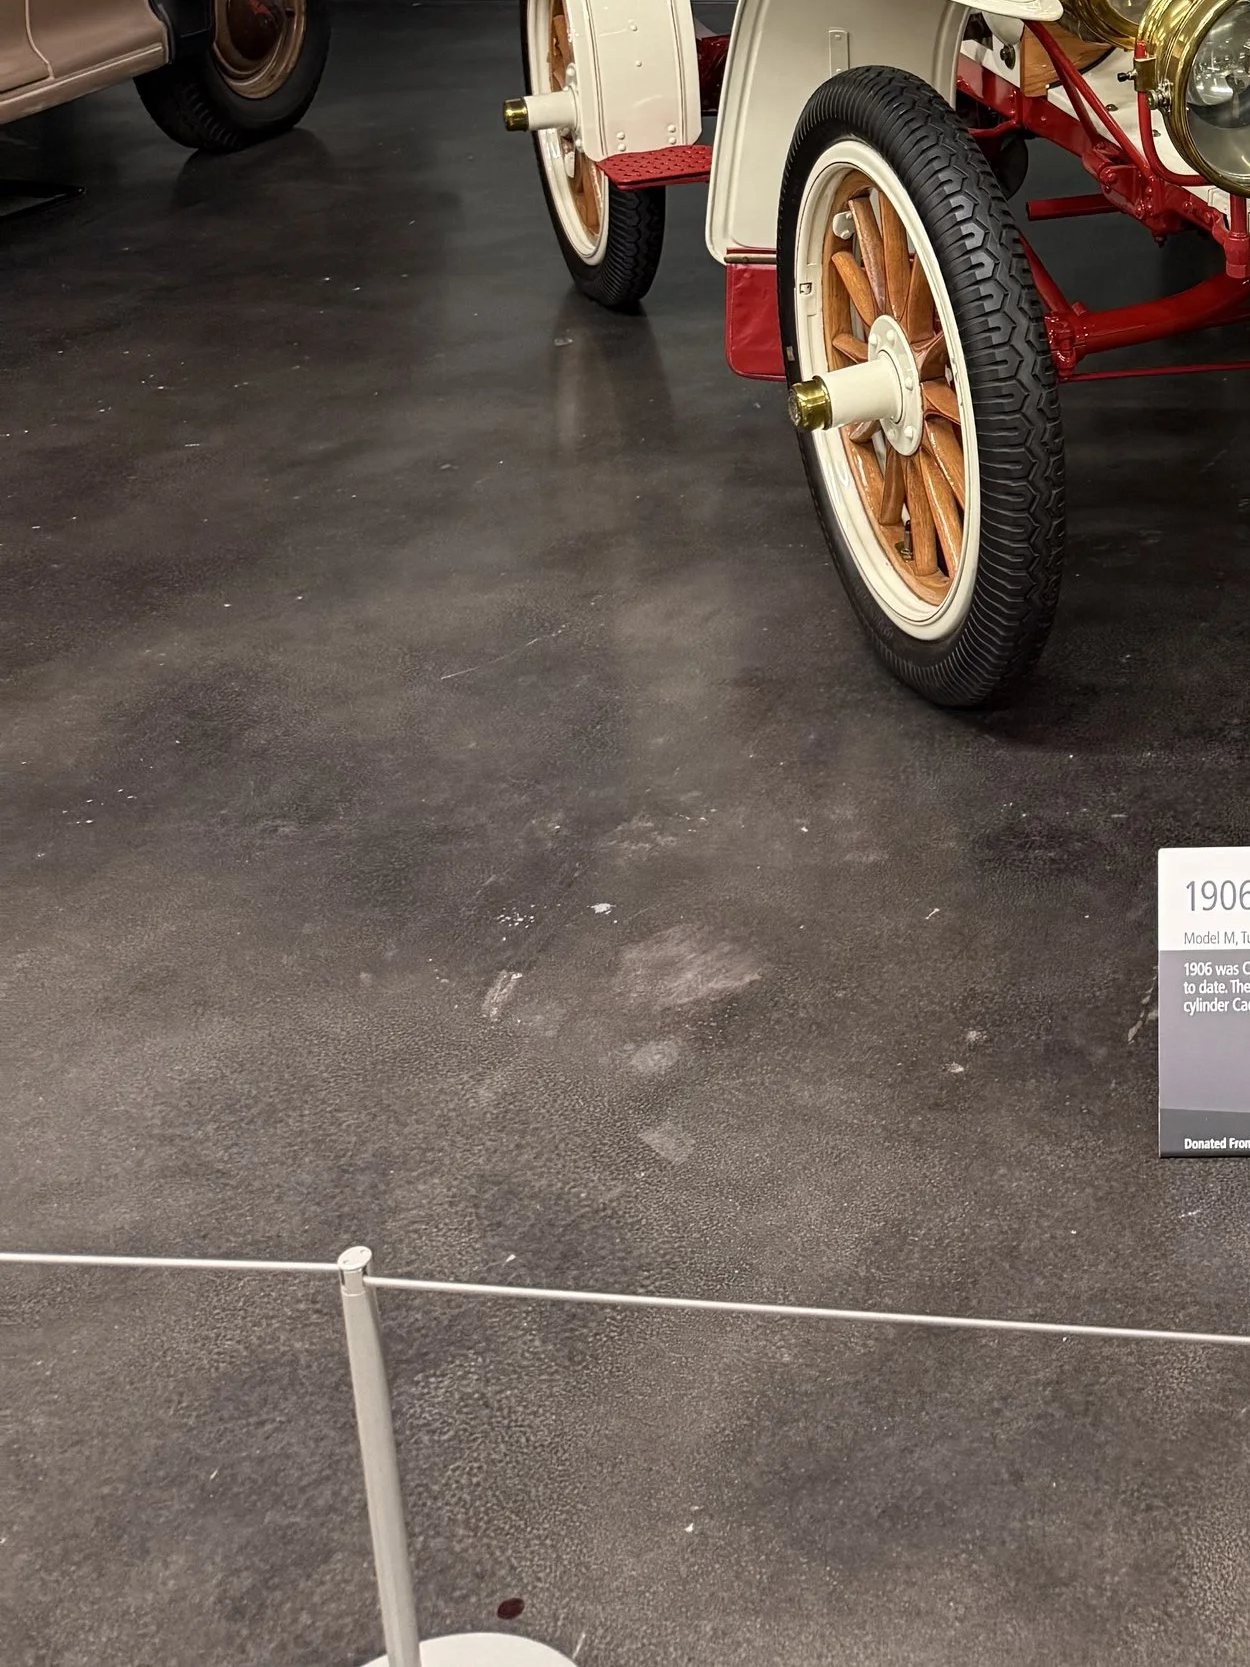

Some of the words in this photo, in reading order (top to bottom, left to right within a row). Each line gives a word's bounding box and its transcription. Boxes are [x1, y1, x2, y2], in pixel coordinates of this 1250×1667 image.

[1184, 931, 1220, 945] Model
[1224, 932, 1238, 945] M,
[1183, 962, 1213, 977] 1906
[1215, 965, 1239, 975] was
[1184, 982, 1195, 994] to
[1198, 979, 1229, 995] date.
[1230, 979, 1250, 993] The
[1183, 997, 1230, 1016] cylinder
[1184, 1137, 1227, 1150] Donated
